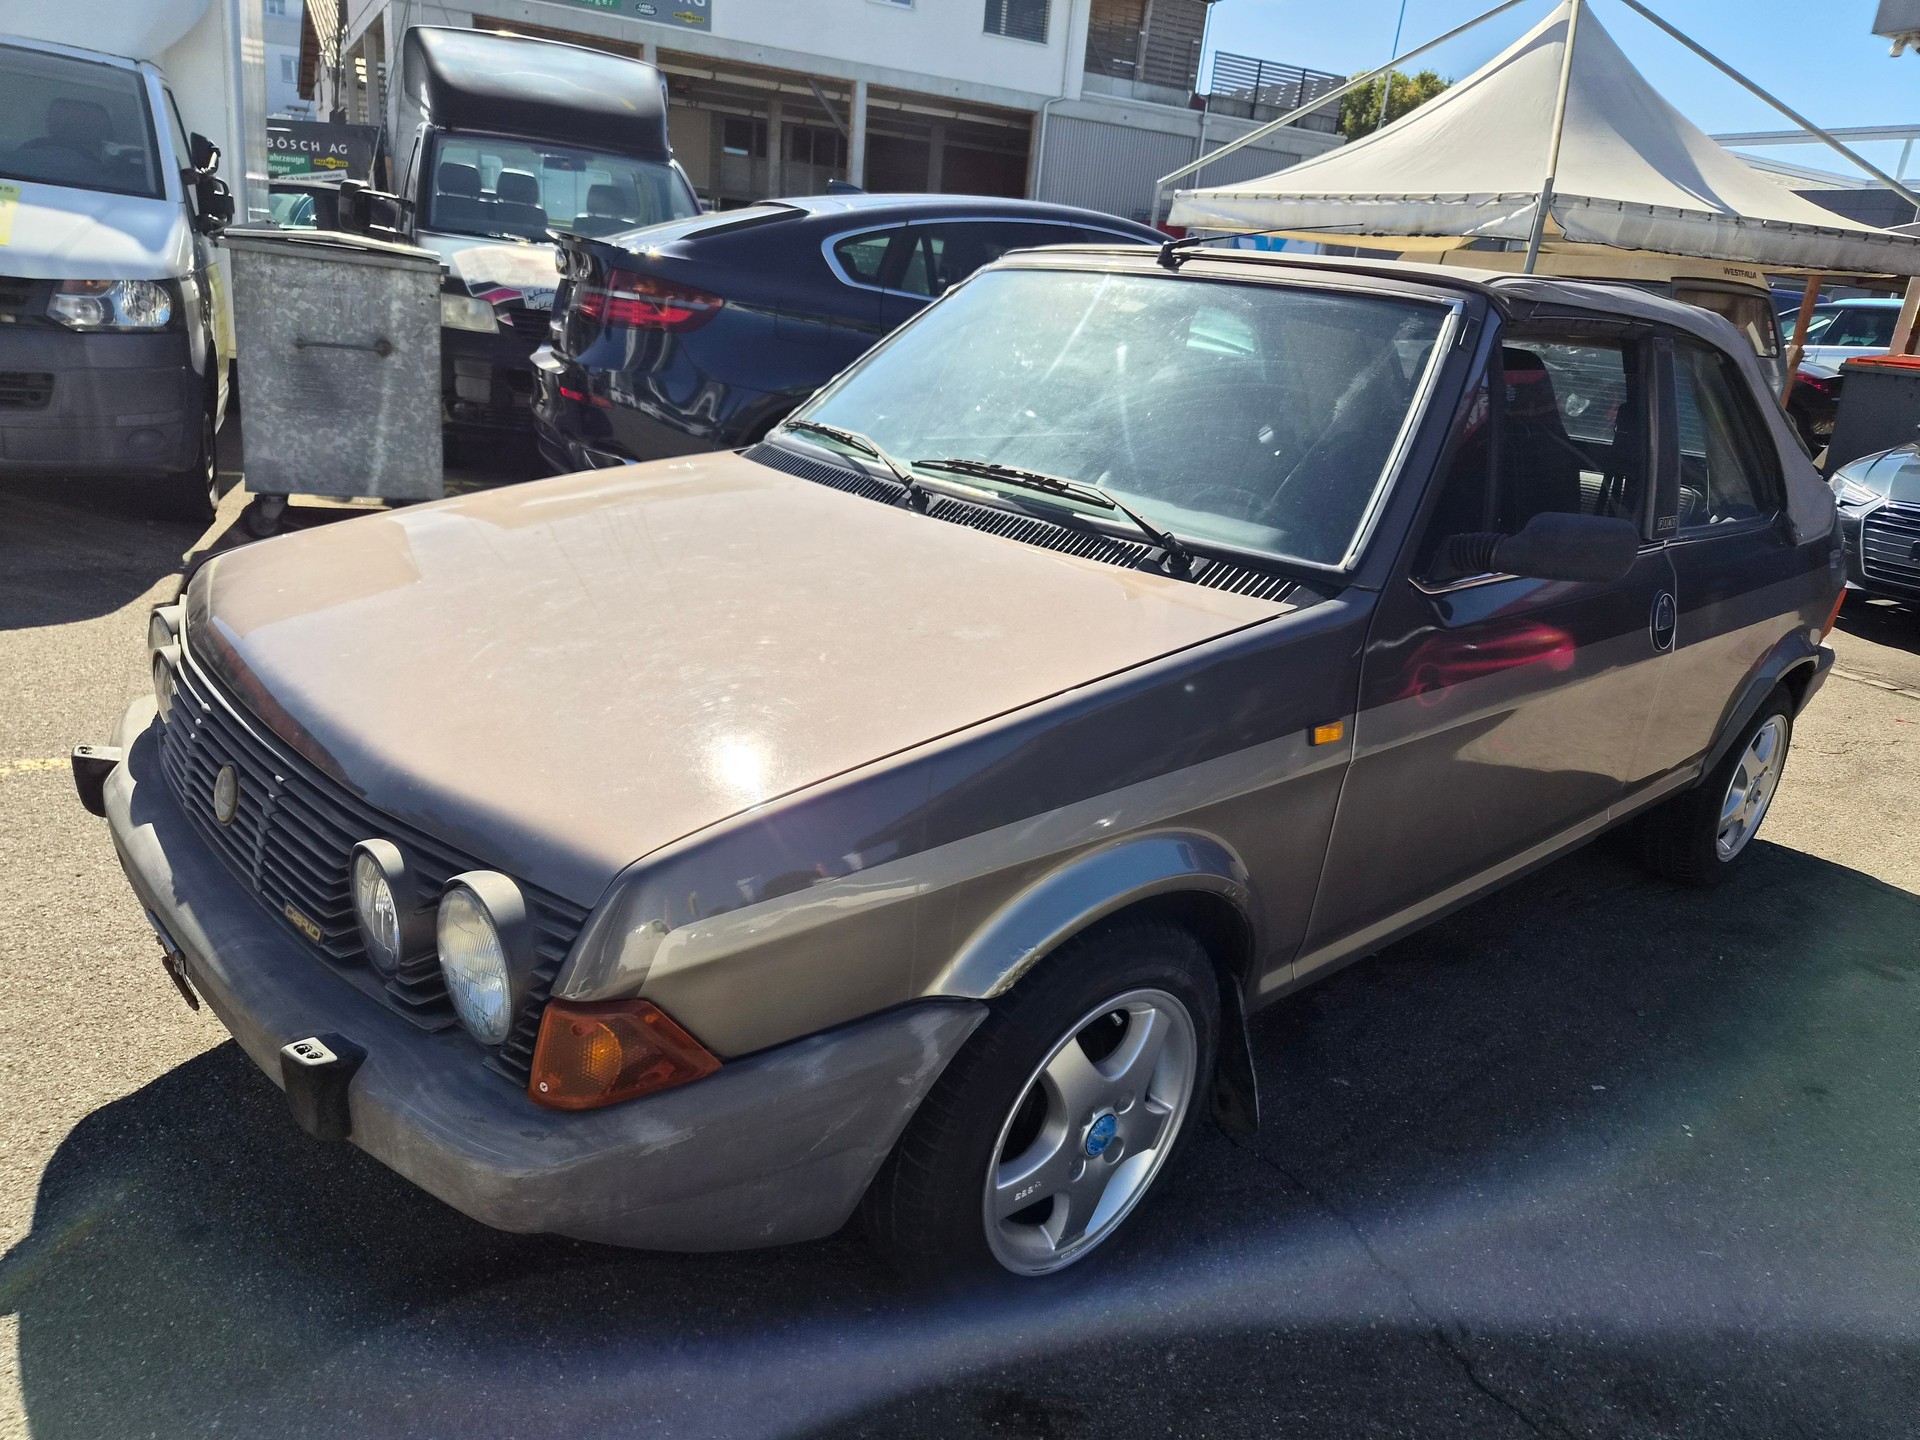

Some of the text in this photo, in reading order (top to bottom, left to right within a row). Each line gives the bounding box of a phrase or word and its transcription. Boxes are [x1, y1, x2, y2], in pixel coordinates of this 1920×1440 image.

[267, 136, 348, 155] BÖSCH AG
[268, 153, 305, 165] ahrzeuge
[1723, 266, 1757, 279] WESTFALIA
